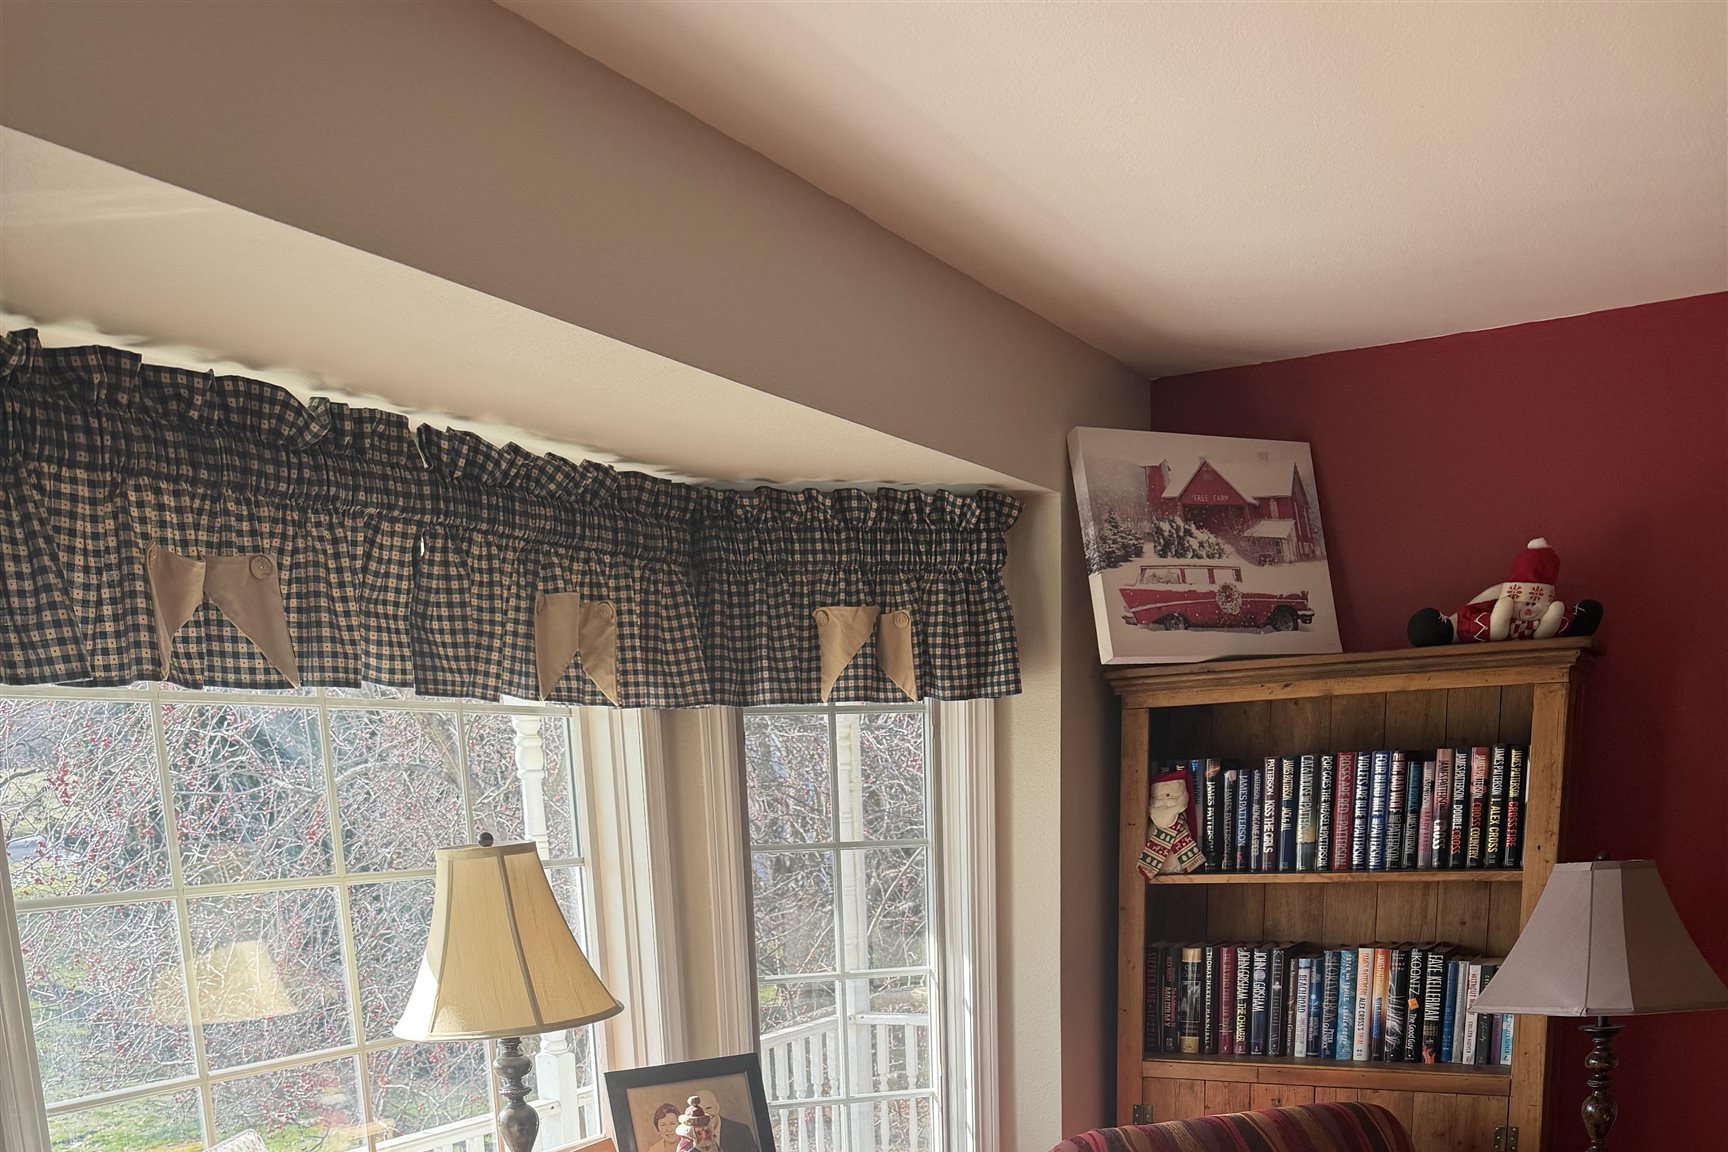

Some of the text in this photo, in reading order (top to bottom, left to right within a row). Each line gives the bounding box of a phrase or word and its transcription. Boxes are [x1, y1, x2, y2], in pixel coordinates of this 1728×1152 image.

[1192, 494, 1229, 503] TREE FARM
[1283, 760, 1294, 774] JAMES
[1322, 756, 1332, 770] POP
[1339, 756, 1350, 779] ROSES
[1375, 754, 1387, 773] FOUR
[1391, 762, 1404, 774] BIG
[1494, 747, 1505, 765] JAMES
[1321, 771, 1332, 788] GOES
[1356, 755, 1370, 784] VIOLETS
[1492, 765, 1504, 795] PATTERSON
[1239, 775, 1248, 801] JAMES
[1283, 775, 1293, 800] PATTERSON
[1301, 774, 1314, 796] MOUSE
[1338, 780, 1350, 796] ARE
[1356, 785, 1368, 799] ARE
[1373, 774, 1386, 796] BLIND
[1390, 775, 1404, 790] BAD
[1264, 759, 1275, 854] PATTERSON KISS THE GIRLS
[1321, 789, 1331, 801] THE
[1338, 798, 1350, 813] RED
[1372, 797, 1384, 816] MICE
[1389, 791, 1403, 812] WOLF
[1432, 760, 1450, 849] JAMES PATTERSON CROSS
[1450, 752, 1467, 854] JAMES PATTERSON DOUBLE CROSS
[1468, 755, 1486, 859] JAMES PATTERSON CROSS COUNTRY
[1506, 750, 1522, 848] JAMES PATTERSON CROSS FIRE
[1206, 782, 1216, 851] JAMES PATTERSON
[1224, 789, 1232, 853] JAMES PATTERSON
[1320, 802, 1330, 826] WEASEL
[1355, 800, 1367, 818] BLUE
[1408, 814, 1416, 828] JAMES
[1490, 806, 1500, 825] ALEX
[1238, 802, 1247, 846] PATTERSON
[1297, 802, 1312, 844] PATTERSON
[1318, 831, 1329, 866] PATTERSON
[1336, 821, 1348, 865] PATTERSON
[1352, 825, 1365, 864] PATTERSON
[1370, 825, 1382, 865] PATTERSON
[1386, 824, 1400, 861] PATTERSON
[1407, 828, 1416, 854] PATTERSON
[1487, 827, 1499, 853] CROSS
[1410, 956, 1422, 995] KOONTZ
[1428, 955, 1443, 973] FAYE
[1252, 951, 1266, 1012] JOHN GRISHAM
[1298, 975, 1308, 994] BEACH
[1164, 986, 1172, 1020] MALCOLM
[1236, 950, 1250, 1042] JOHN GRISHAM THE CHAMBER
[1298, 996, 1306, 1013] ROAD
[1424, 976, 1442, 1021] KELLERMAN
[1204, 1008, 1212, 1044] HANNIBAL
[1408, 1024, 1416, 1038] Good
[1406, 1039, 1415, 1050] Guy
